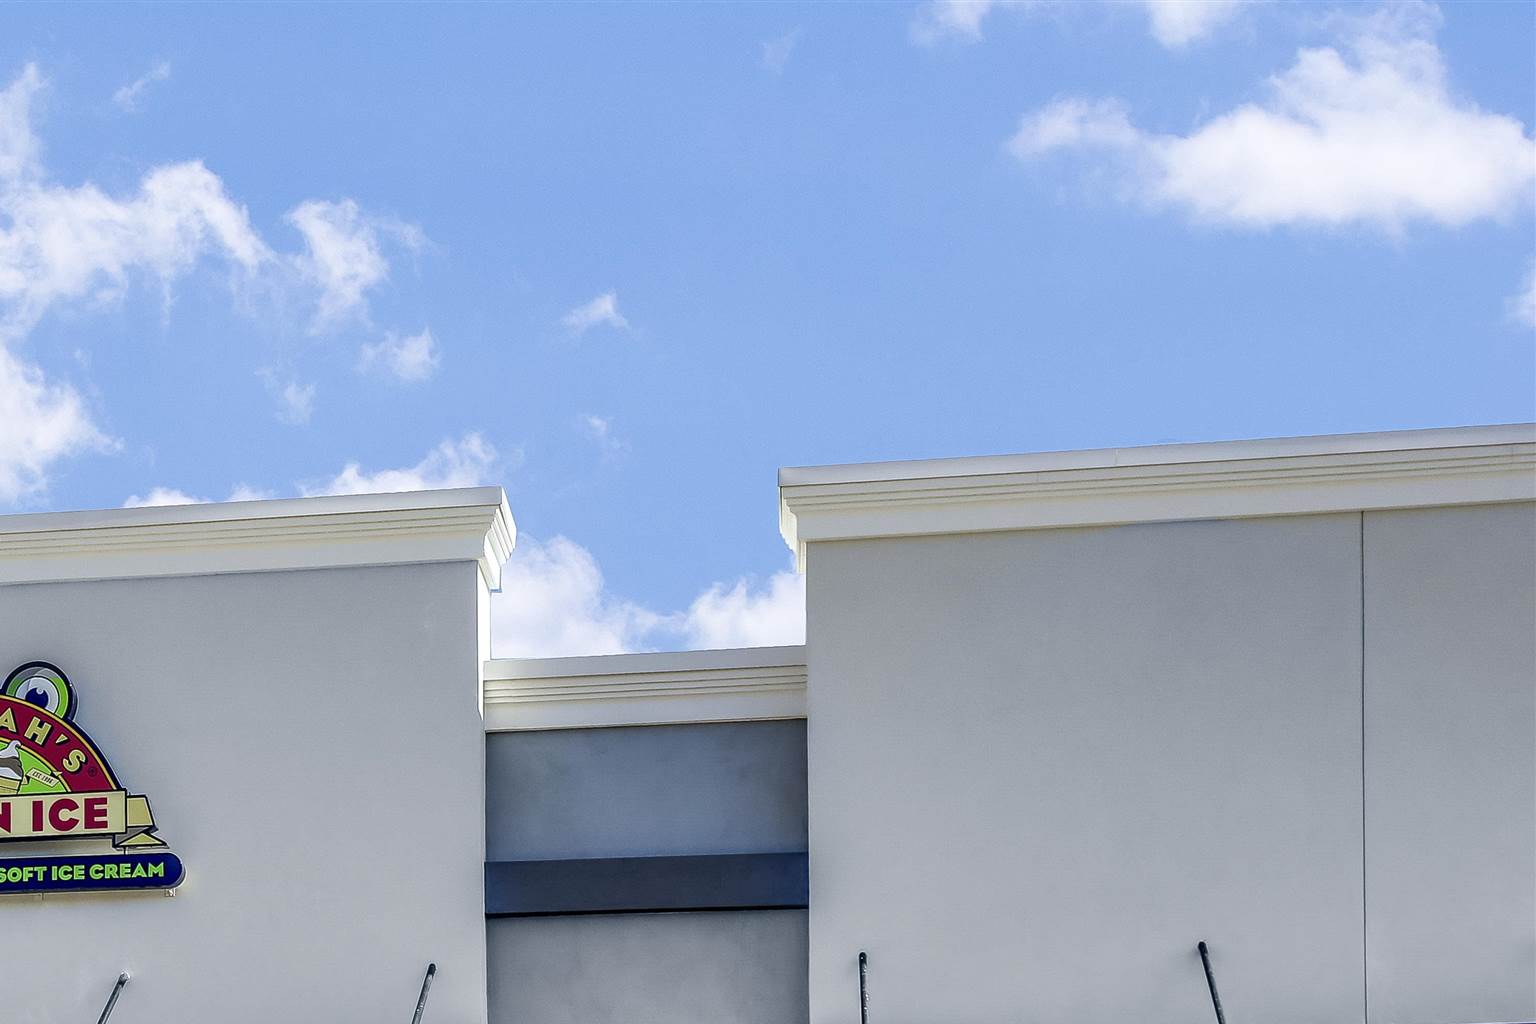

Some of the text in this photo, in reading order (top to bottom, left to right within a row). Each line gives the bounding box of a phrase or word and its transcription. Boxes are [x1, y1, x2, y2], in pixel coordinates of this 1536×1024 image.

[32, 797, 109, 832] ICE
[51, 864, 85, 881] ICE
[89, 862, 164, 879] CREAM
